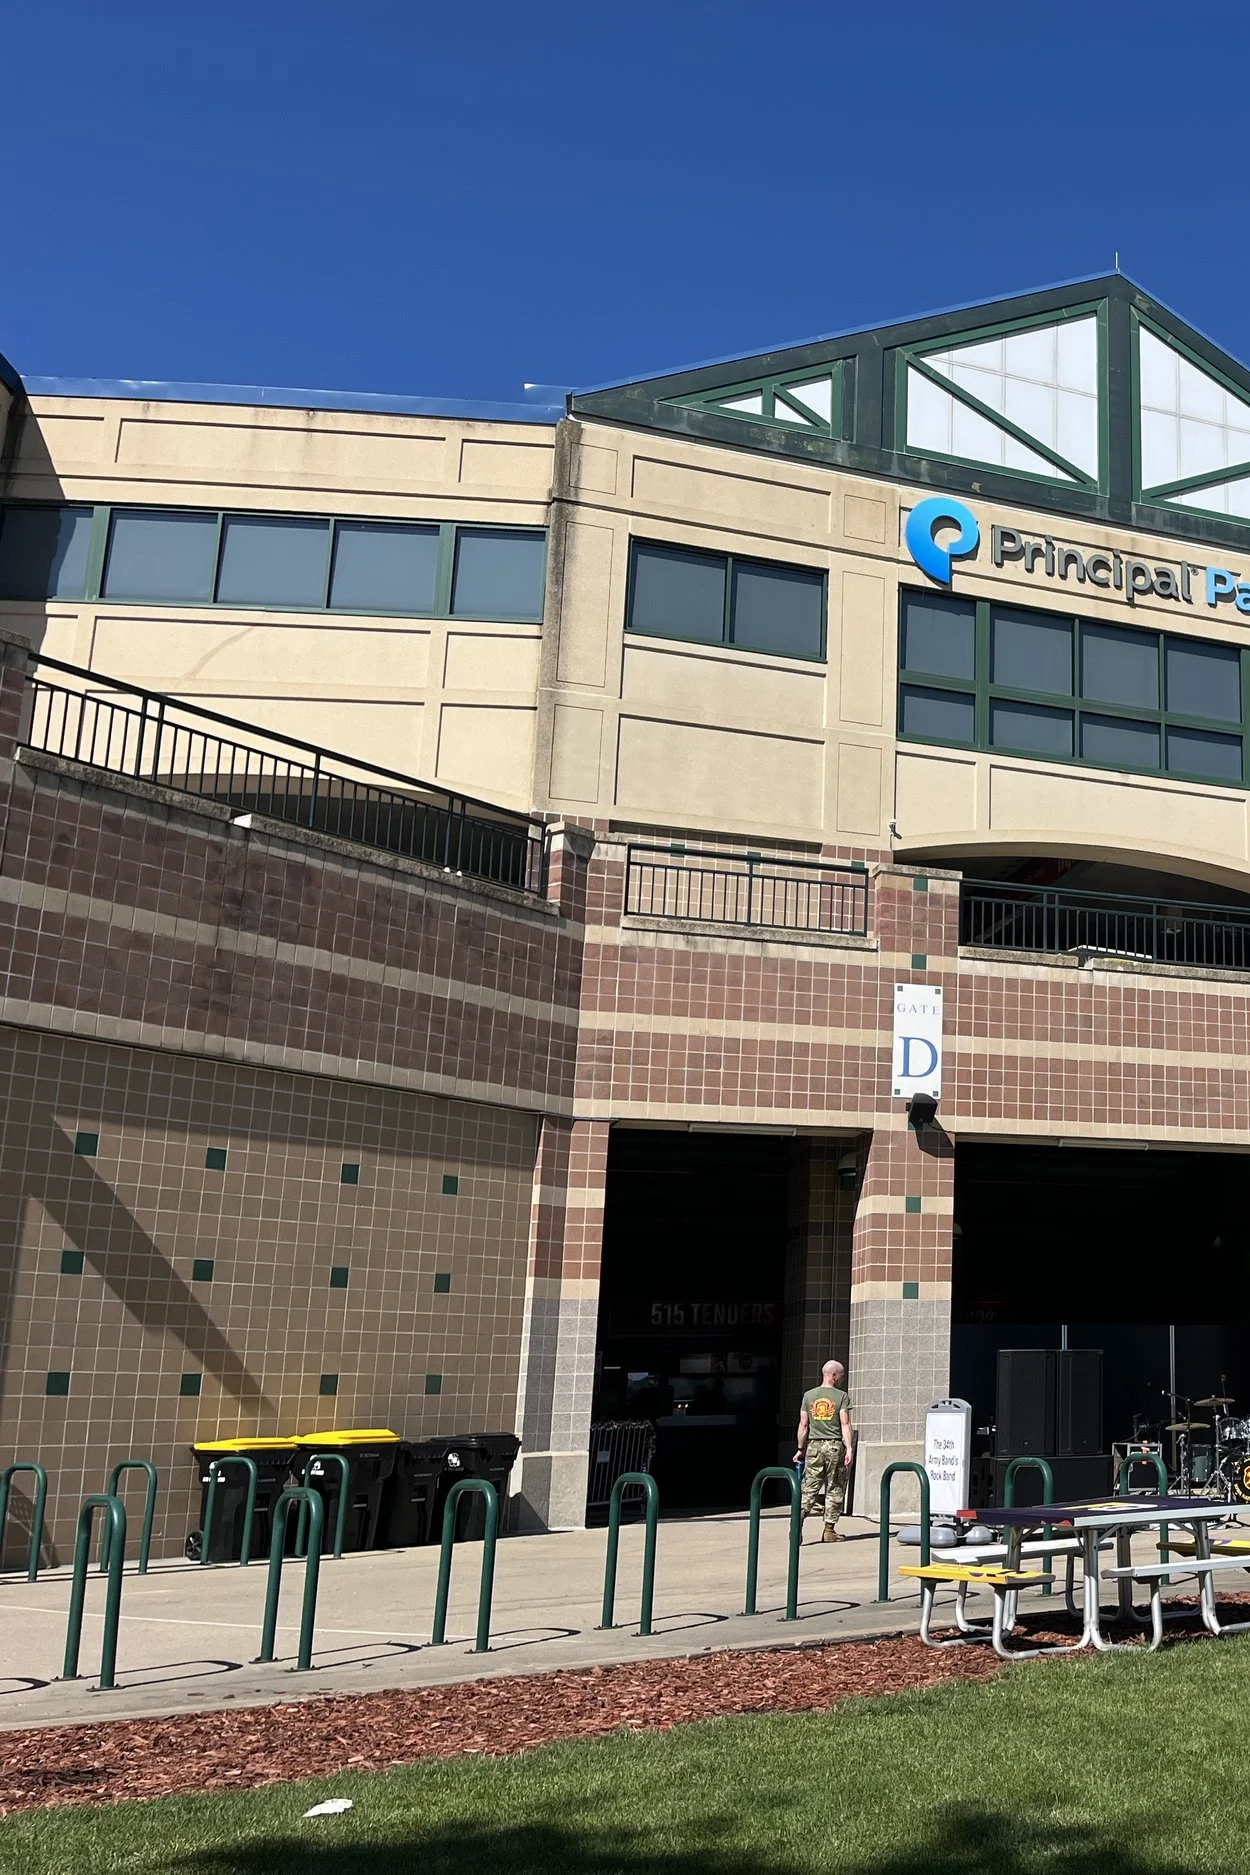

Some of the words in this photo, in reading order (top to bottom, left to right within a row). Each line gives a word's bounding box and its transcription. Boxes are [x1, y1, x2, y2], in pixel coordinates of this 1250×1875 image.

[992, 525, 1192, 600] Principal
[896, 1003, 940, 1015] GATE
[897, 1036, 938, 1077] D
[651, 1303, 685, 1326] 515
[690, 1303, 775, 1326] TENDERS
[933, 1439, 942, 1450] The
[942, 1439, 955, 1450] 34th
[928, 1454, 941, 1467] Army
[942, 1454, 958, 1466] Band's
[930, 1469, 942, 1480] Rock
[943, 1470, 955, 1481] Band
